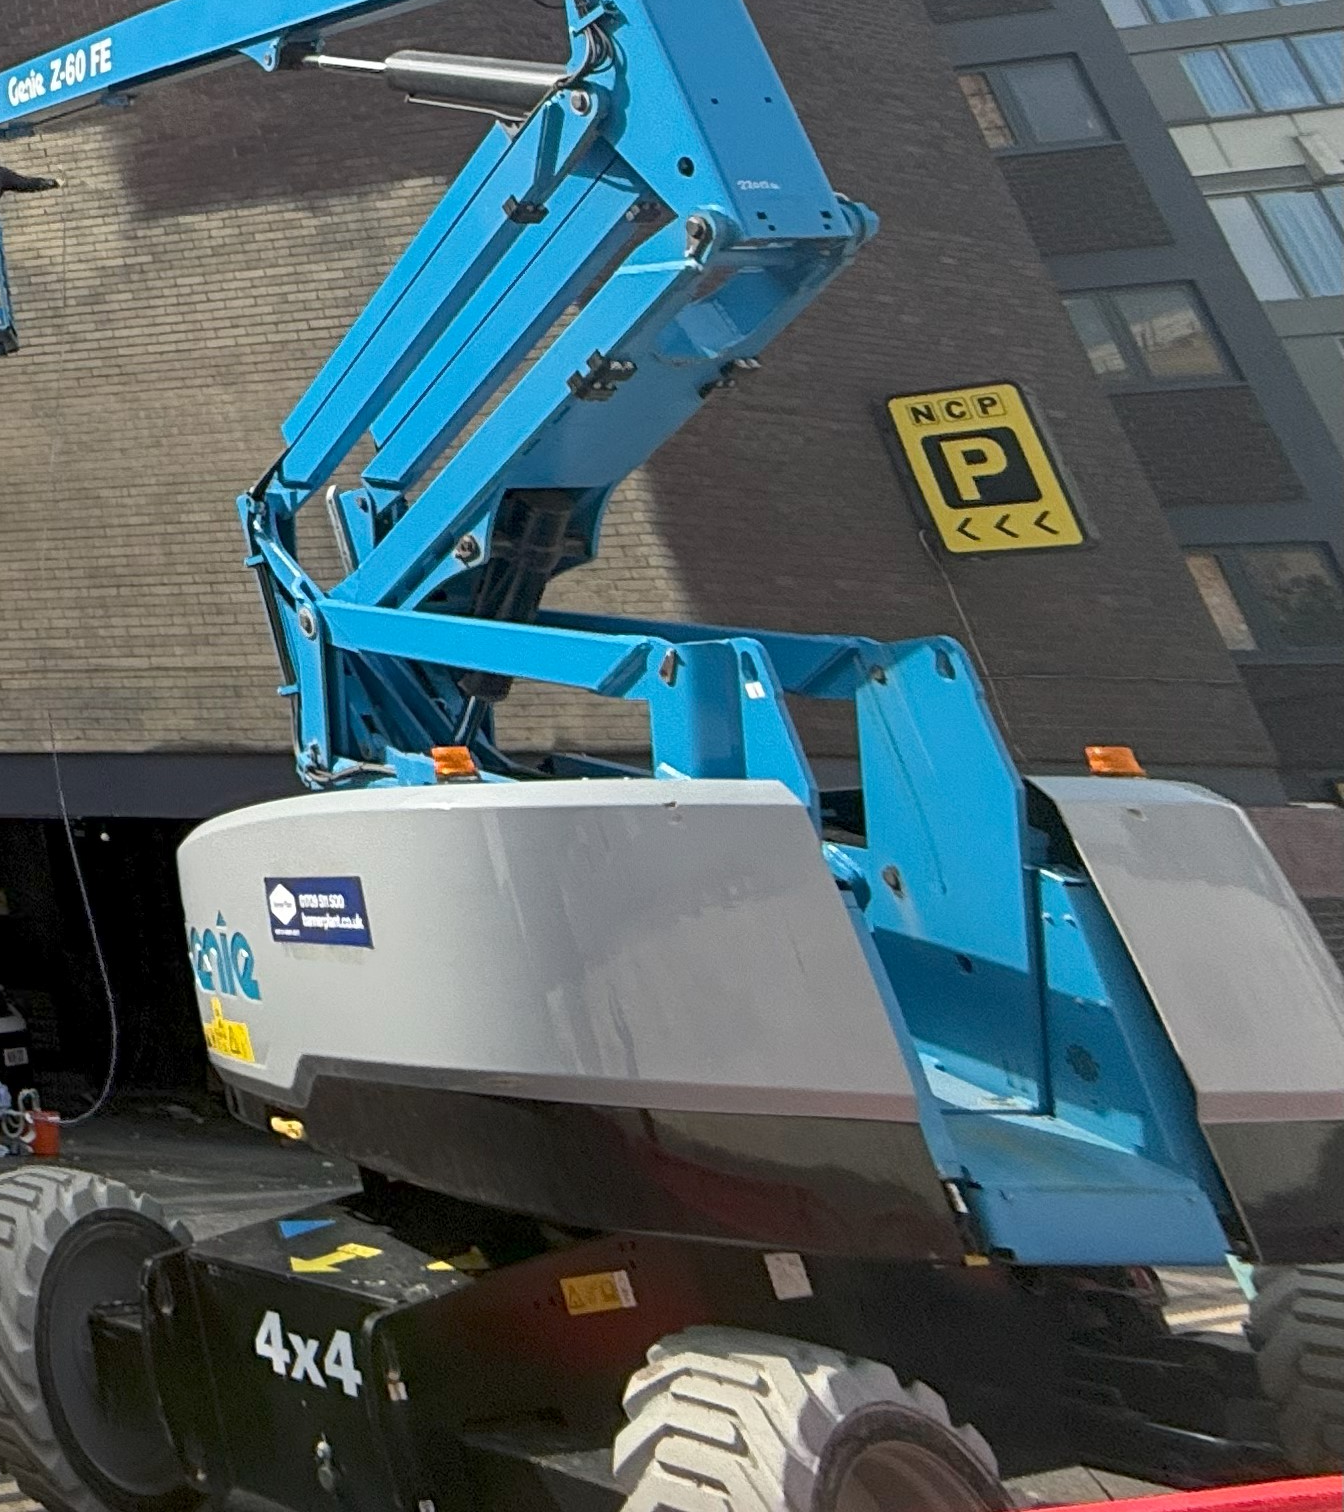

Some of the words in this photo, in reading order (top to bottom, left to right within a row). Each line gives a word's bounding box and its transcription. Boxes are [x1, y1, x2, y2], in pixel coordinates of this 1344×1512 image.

[8, 68, 47, 107] Genie
[50, 48, 87, 92] Z-60
[90, 37, 112, 77] FE
[940, 437, 1008, 501] P
[190, 910, 262, 1001] enie
[255, 1310, 363, 1398] 4x4
